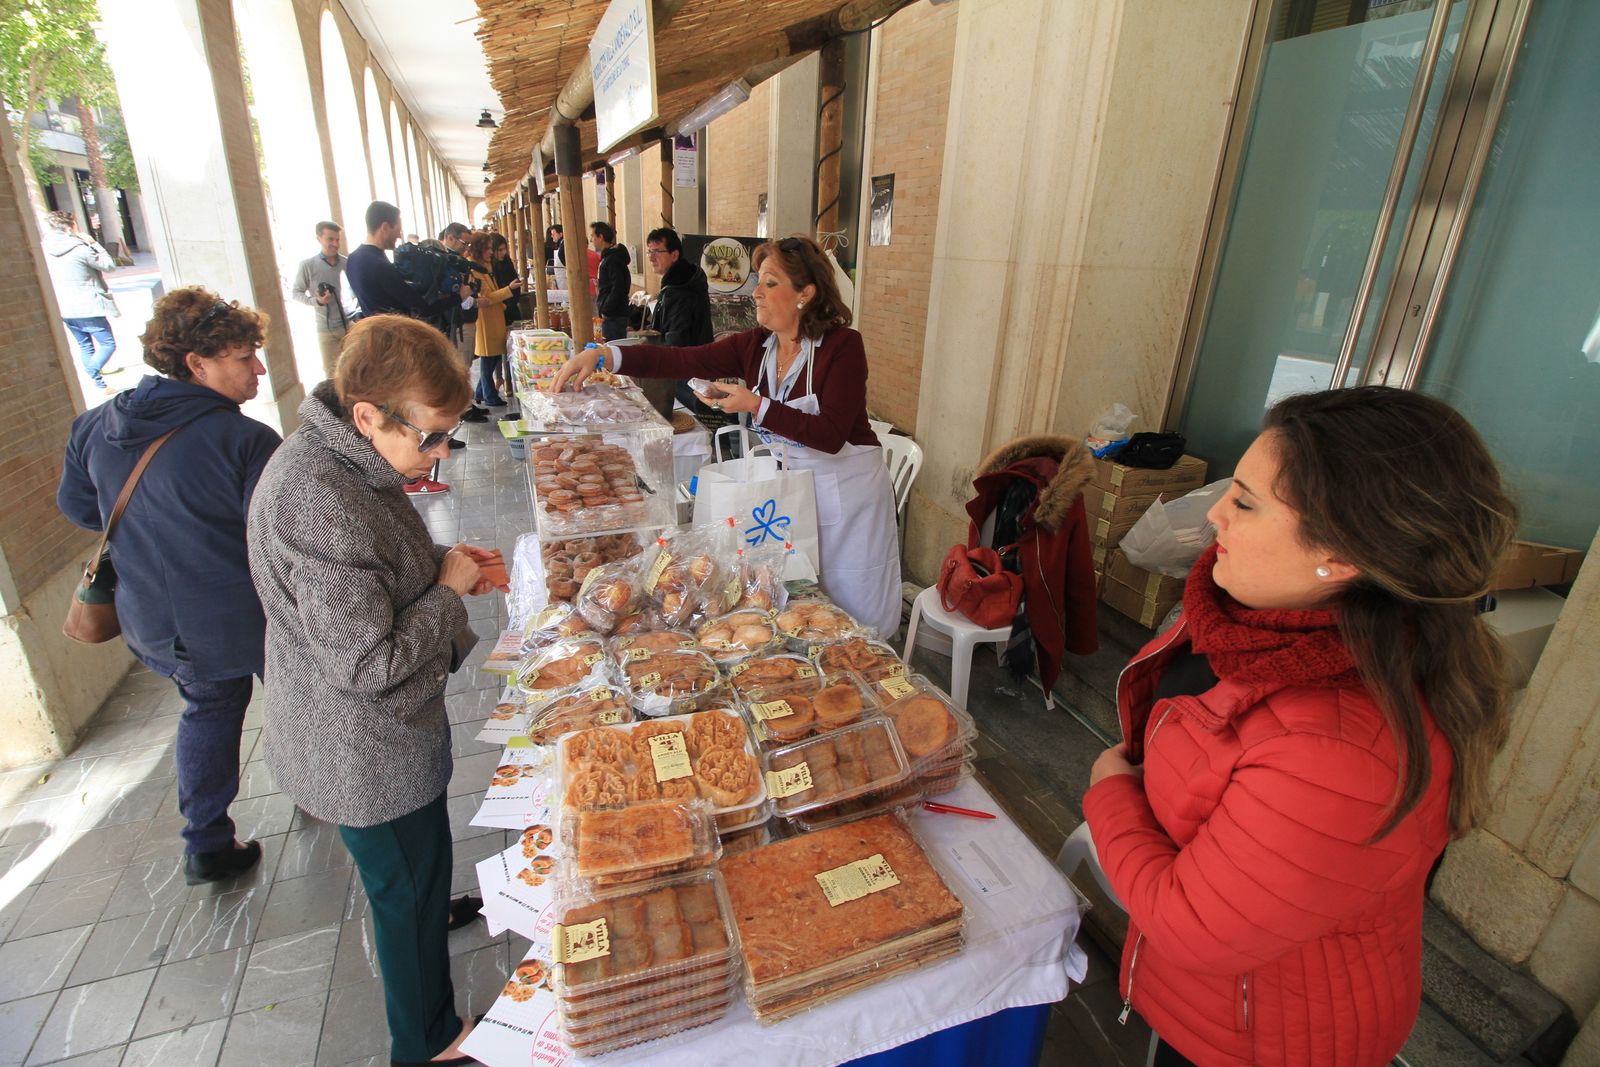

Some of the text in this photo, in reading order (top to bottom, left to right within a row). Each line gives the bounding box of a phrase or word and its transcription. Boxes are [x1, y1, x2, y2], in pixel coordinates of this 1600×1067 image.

[703, 243, 750, 258] CANDÓN
[652, 734, 679, 742] VILLA
[800, 765, 809, 786] VILLA
[881, 860, 895, 879] VILLA
[596, 923, 605, 952] VILLA
